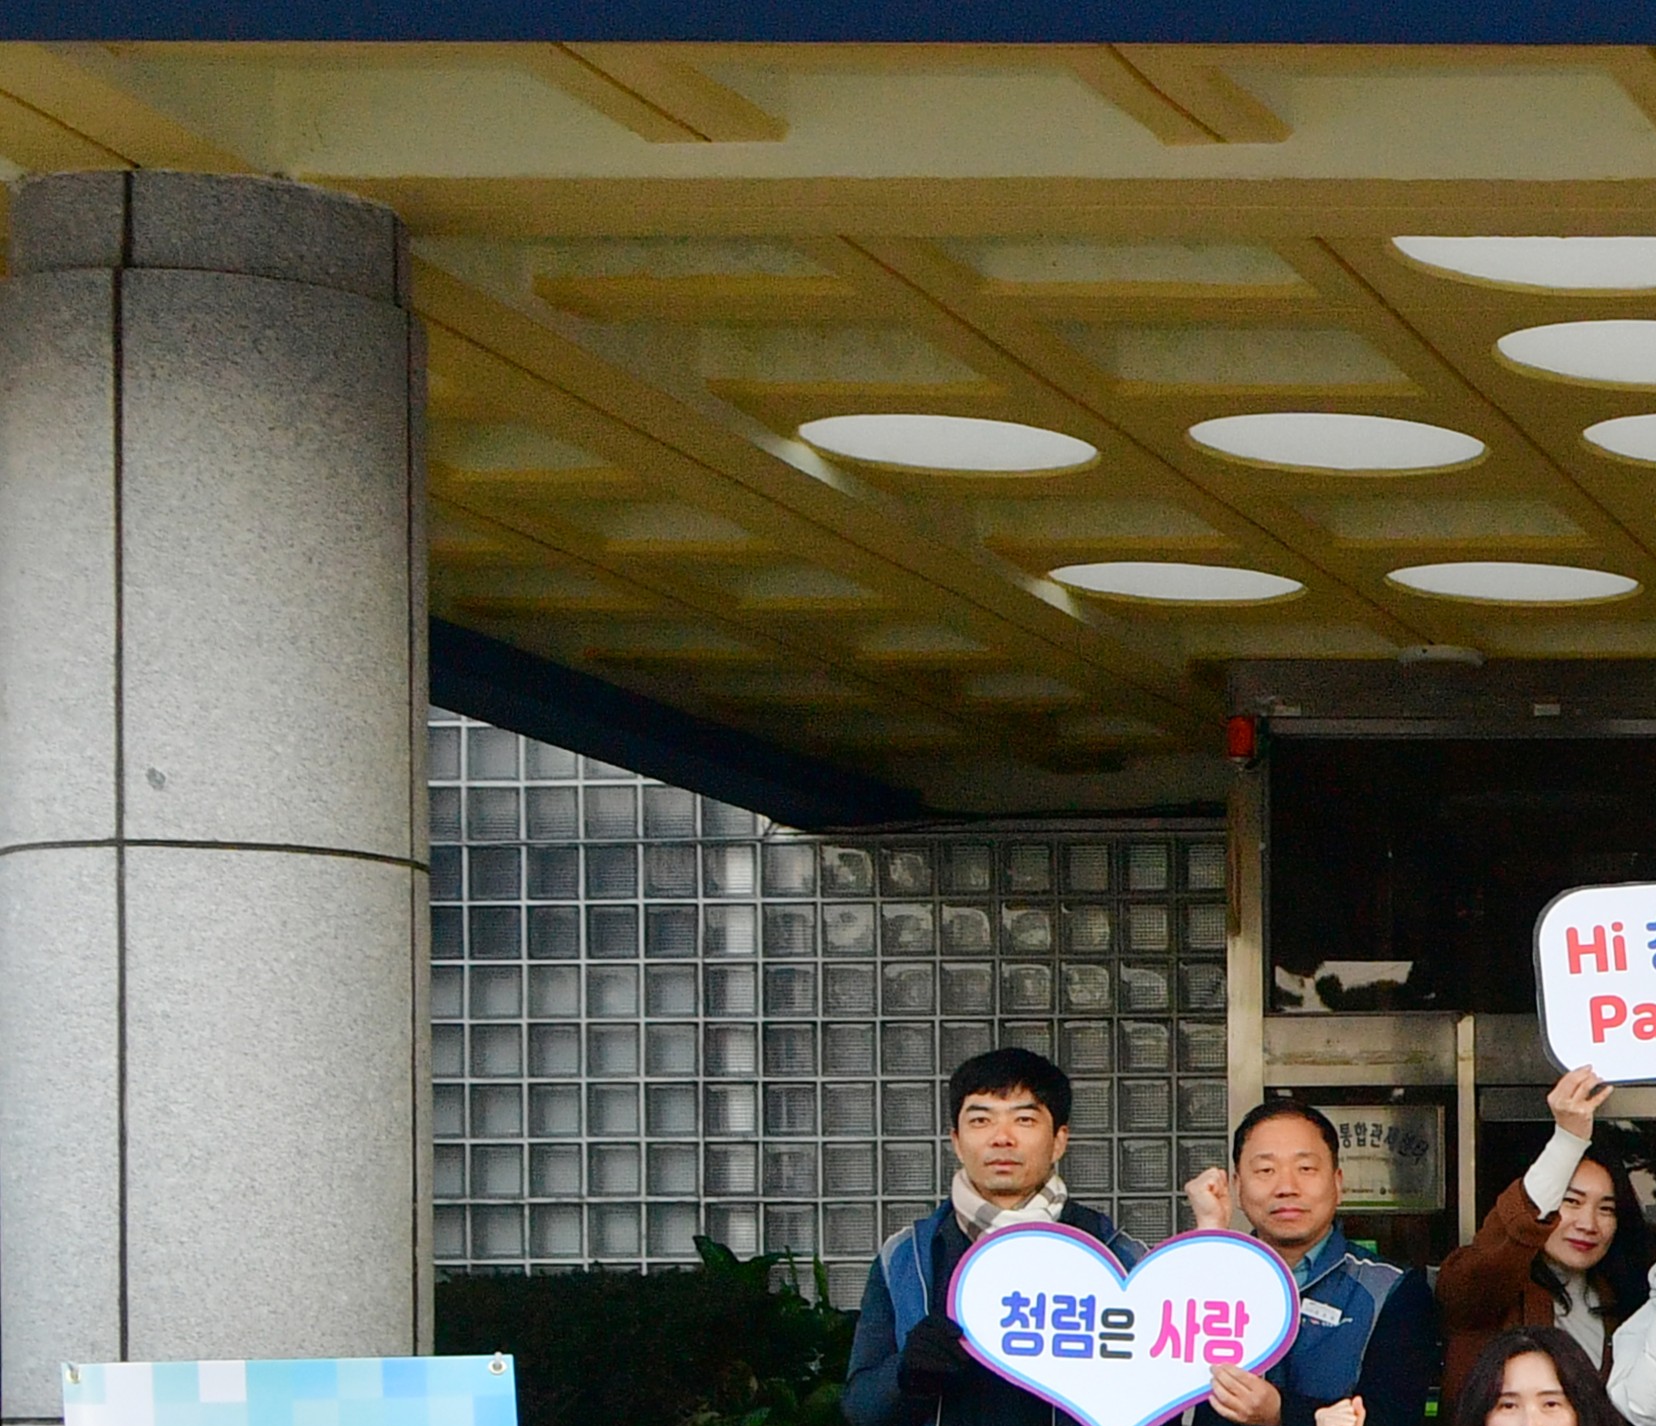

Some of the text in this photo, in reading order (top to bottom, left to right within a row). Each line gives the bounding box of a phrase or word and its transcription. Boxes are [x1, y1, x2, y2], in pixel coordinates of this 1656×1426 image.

[1566, 922, 1627, 974] Hi
[999, 1290, 1250, 1365] 청렴은 사랑
